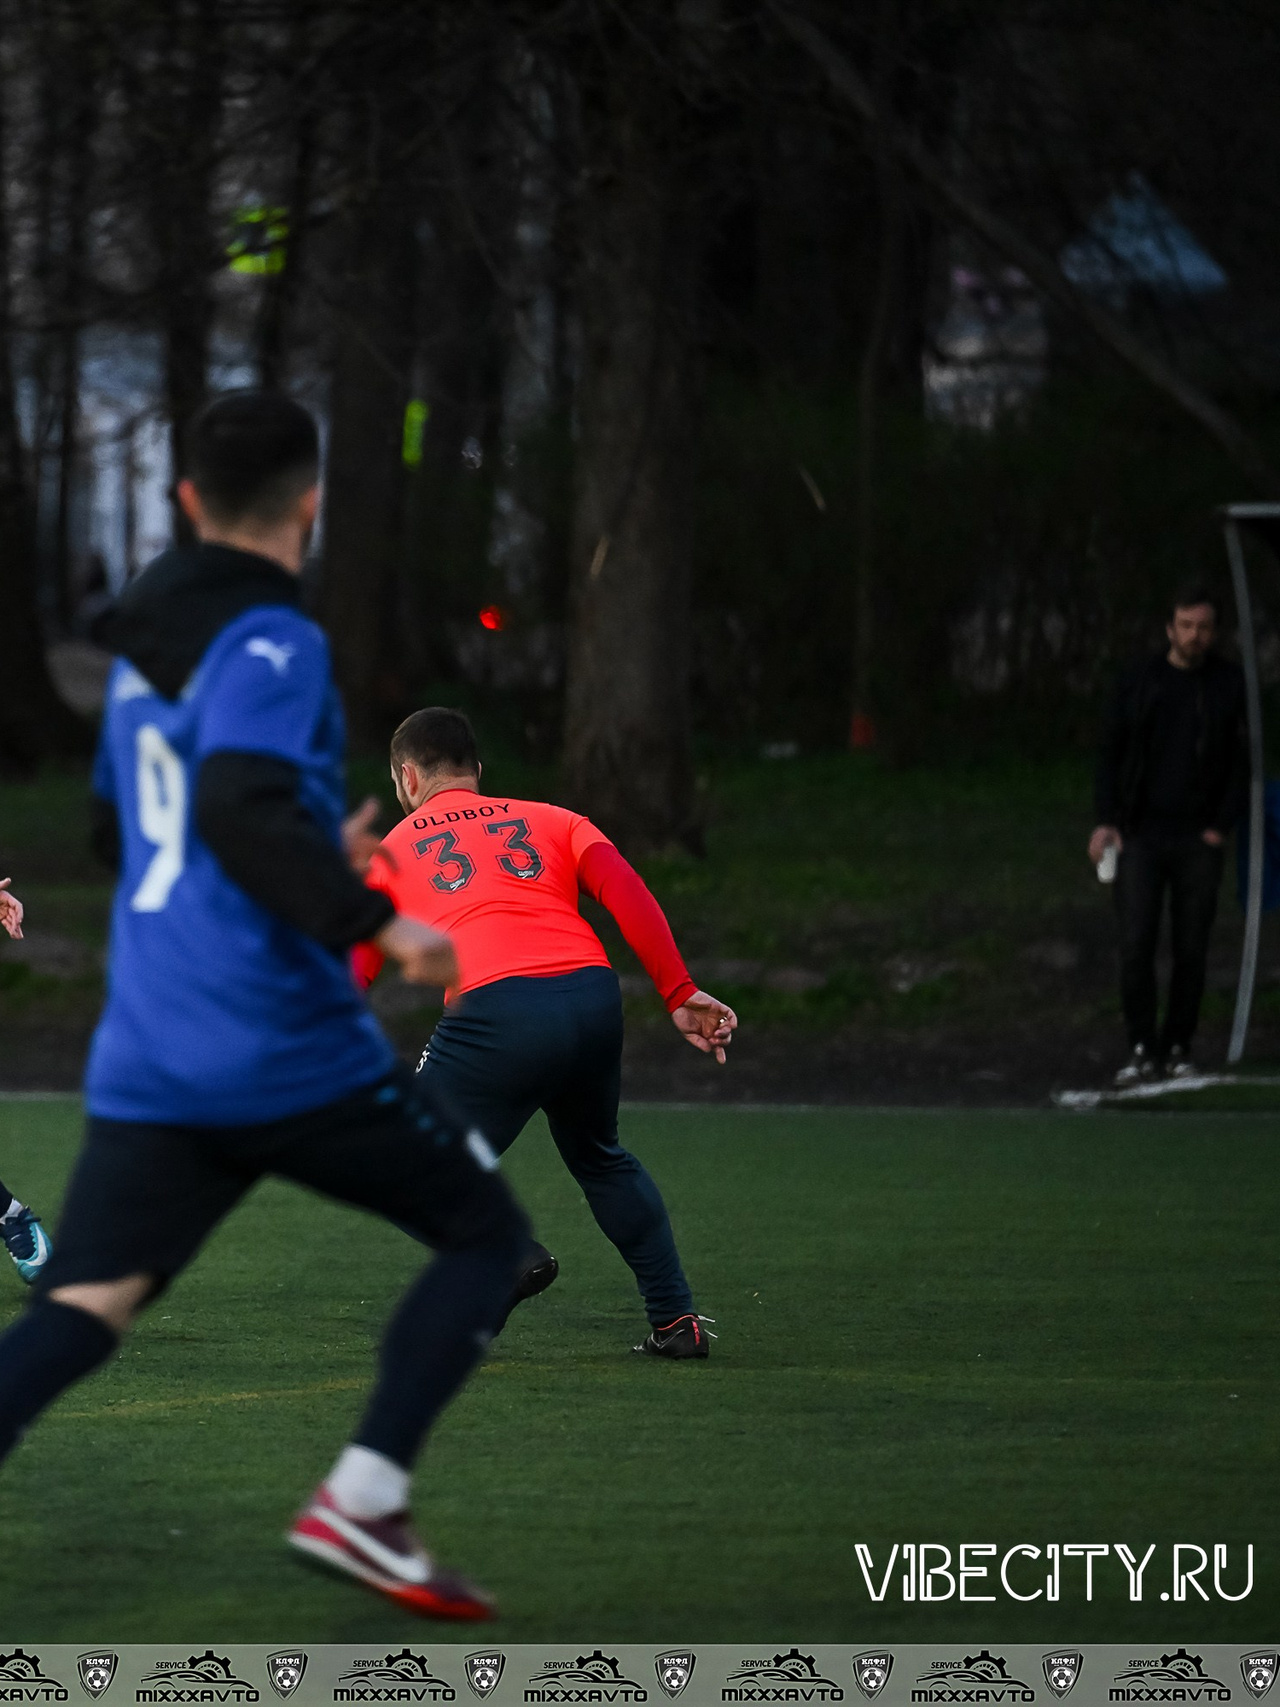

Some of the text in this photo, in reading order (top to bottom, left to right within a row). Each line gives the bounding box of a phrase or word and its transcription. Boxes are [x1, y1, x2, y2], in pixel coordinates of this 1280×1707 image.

[129, 723, 186, 913] 9
[412, 803, 510, 830] OLDBOY
[411, 817, 546, 895] 33
